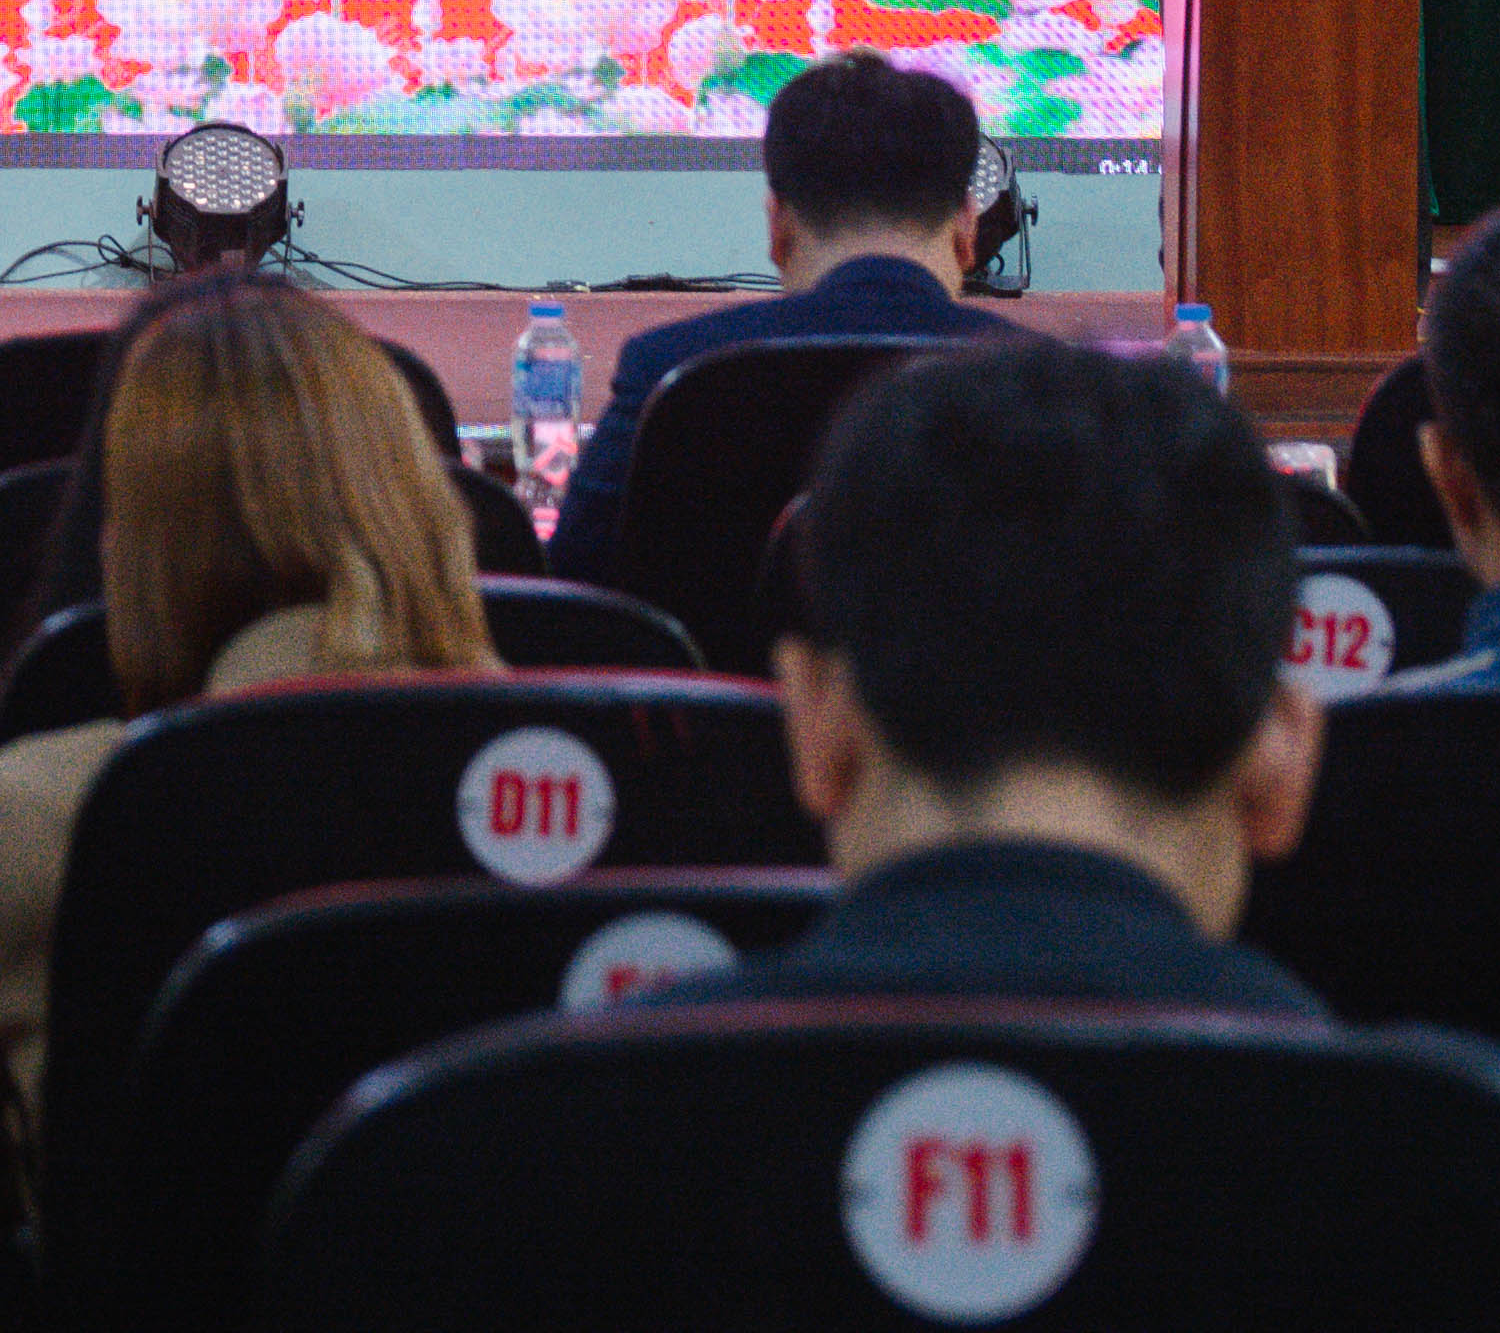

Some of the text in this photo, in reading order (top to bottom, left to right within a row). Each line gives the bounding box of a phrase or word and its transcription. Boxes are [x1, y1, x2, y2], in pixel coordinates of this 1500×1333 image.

[1283, 608, 1370, 668] C12
[490, 770, 582, 838] D11
[906, 1139, 1032, 1242] F11
